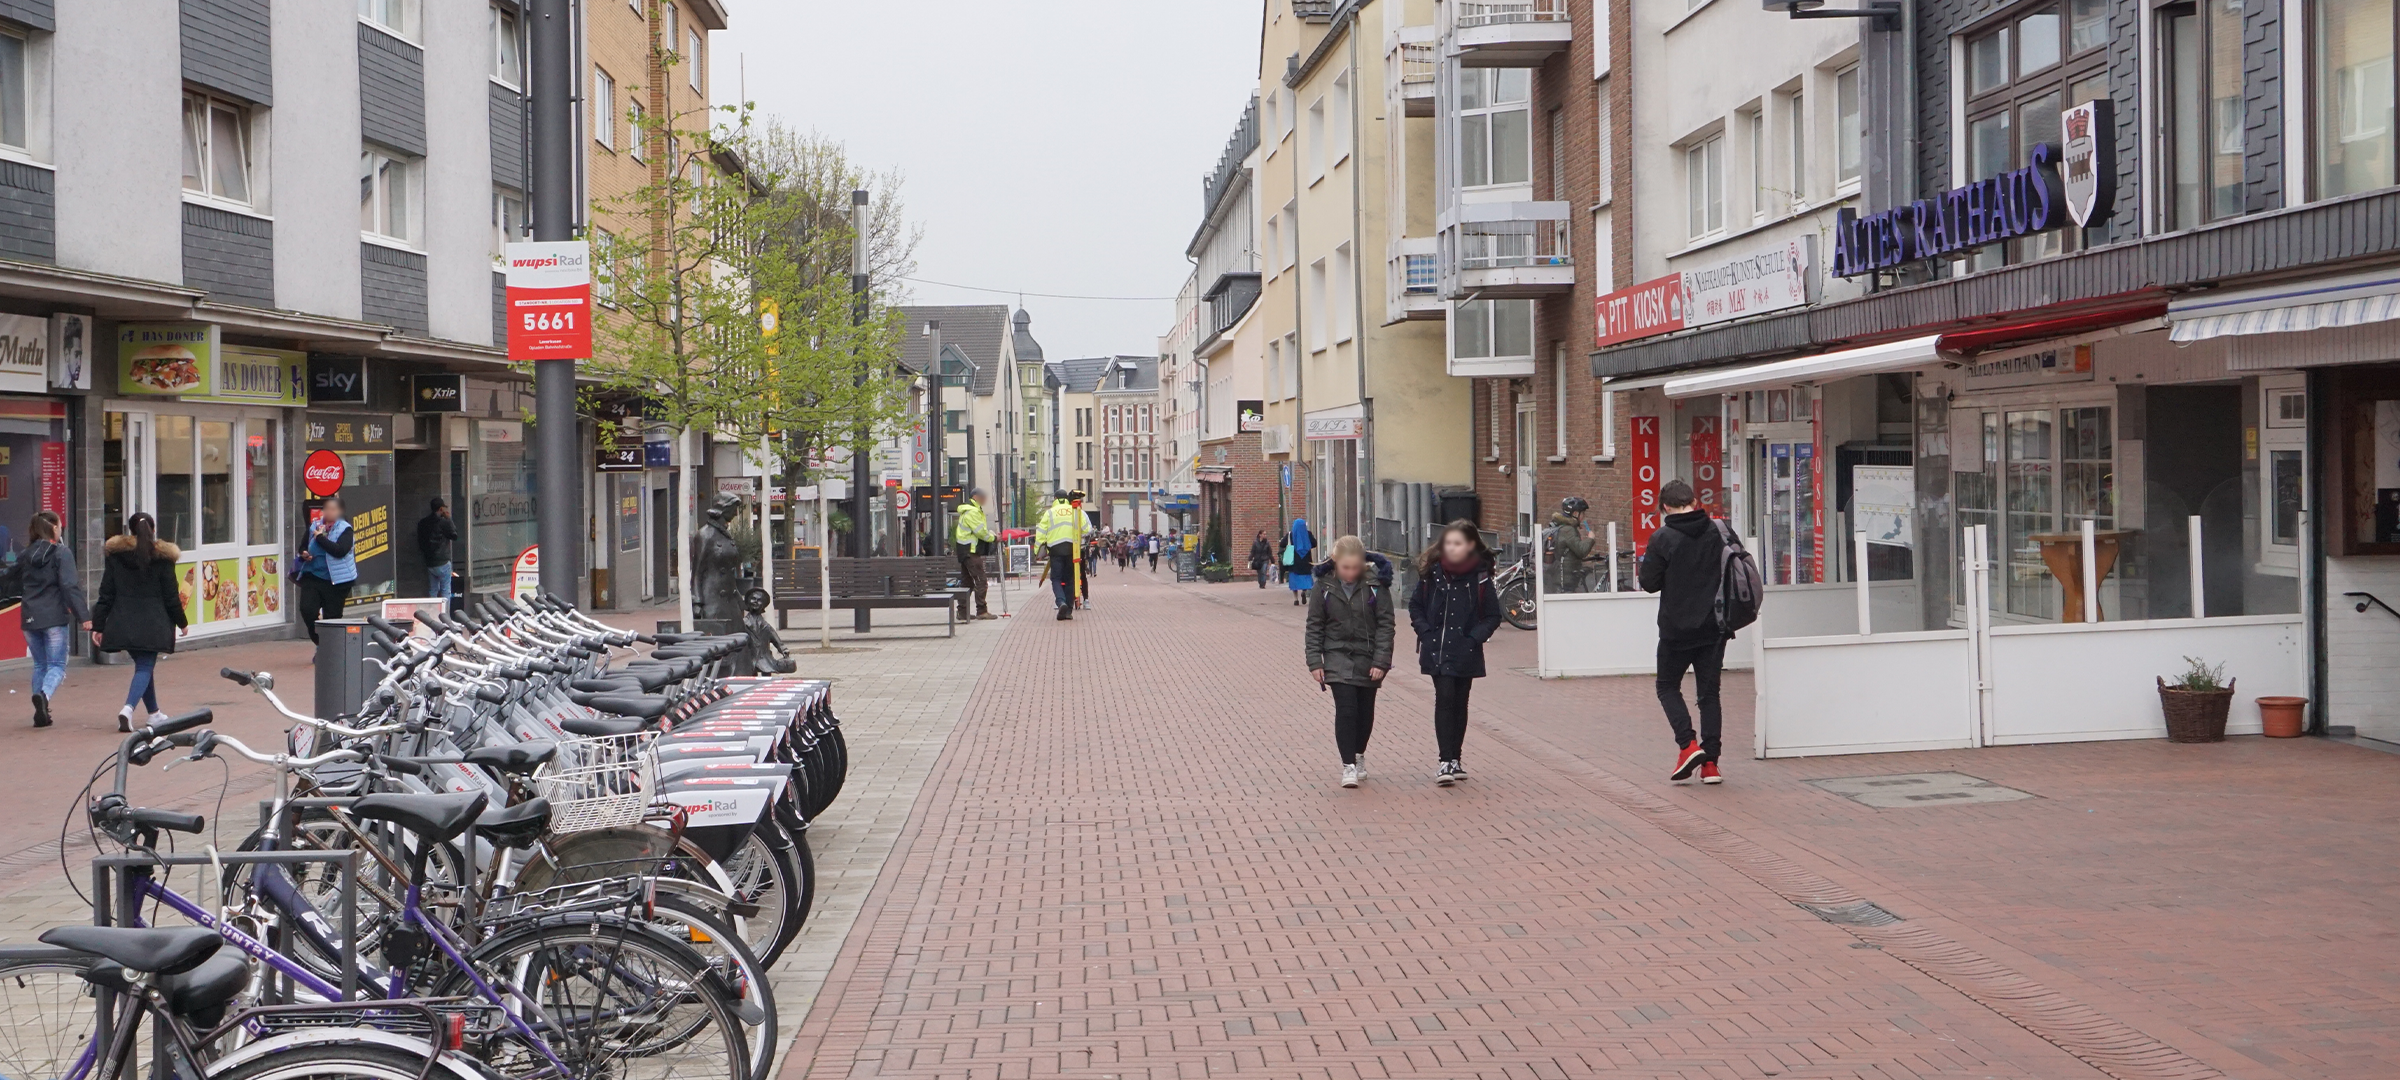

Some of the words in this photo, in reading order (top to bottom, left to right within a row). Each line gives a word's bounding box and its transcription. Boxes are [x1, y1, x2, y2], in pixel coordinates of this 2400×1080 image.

[1832, 207, 1903, 278] ALTES
[1912, 142, 2049, 259] RATHAUS
[513, 254, 557, 270] wupsi
[560, 254, 582, 266] Rad
[1609, 296, 1628, 335] PTT
[1633, 286, 1667, 330] KIOSK
[1729, 288, 1746, 313] MAY
[524, 312, 573, 330] 5661
[142, 331, 163, 341] HAS
[166, 329, 204, 341] DÖNER
[0, 335, 44, 366] Mutlu
[220, 362, 237, 391] AS
[240, 360, 282, 393] DÖNER
[316, 367, 357, 392] sky
[611, 403, 626, 416] 24
[334, 432, 354, 443] WETTEN
[620, 450, 634, 463] 24
[1638, 418, 1656, 530] KIOSK
[353, 511, 370, 532] DEIN
[371, 505, 387, 524] WEG
[376, 532, 388, 546] HIER
[714, 799, 737, 811] Rad
